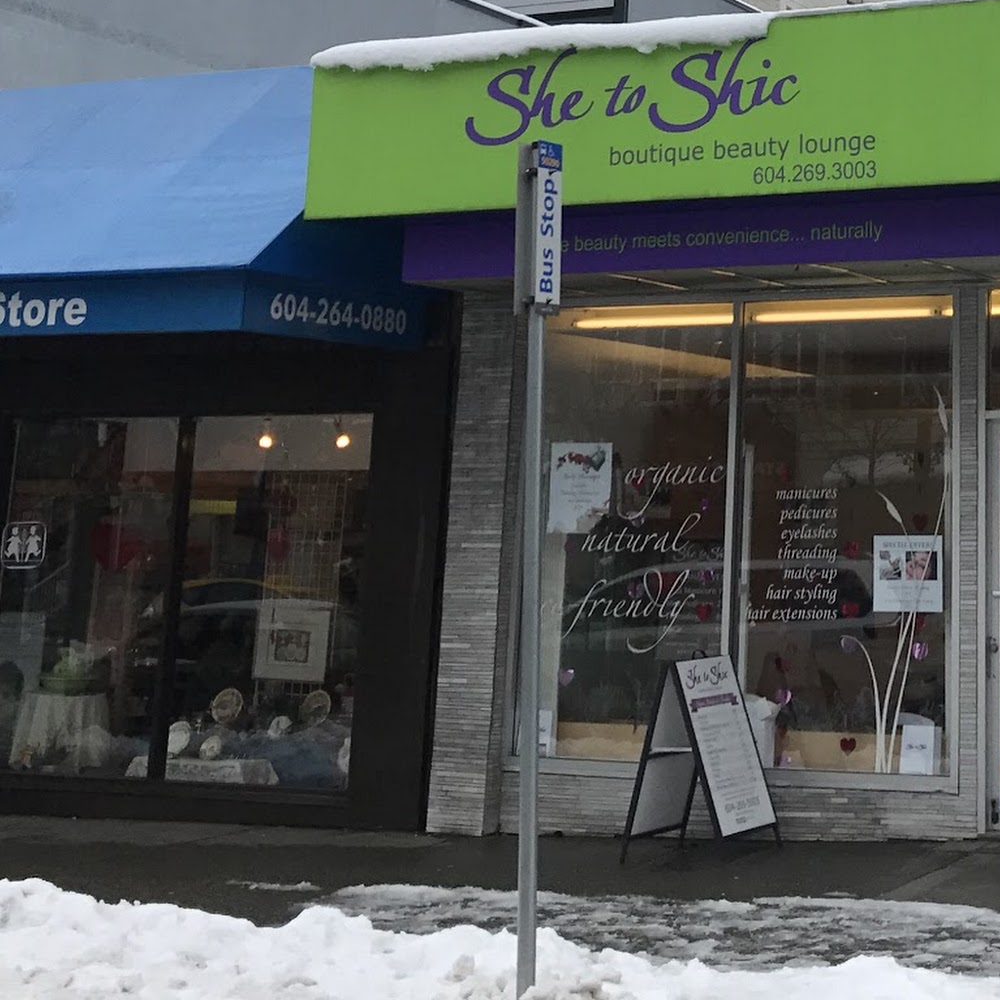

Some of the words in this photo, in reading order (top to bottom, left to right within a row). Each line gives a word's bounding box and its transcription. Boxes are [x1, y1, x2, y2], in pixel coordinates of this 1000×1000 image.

[465, 45, 594, 146] She
[605, 75, 646, 117] to
[648, 36, 800, 133] Shic
[609, 143, 704, 166] boutique
[714, 137, 789, 161] beauty
[800, 133, 876, 156] lounge
[753, 160, 877, 184] 604.269.3003
[540, 178, 558, 238] Stop
[575, 235, 626, 253] beauty
[632, 232, 681, 249] meets
[811, 220, 883, 242] naturally
[539, 247, 554, 294] Bus
[270, 292, 407, 335] 604-264-0880
[617, 456, 724, 520] organic
[776, 486, 838, 500] manicures
[779, 504, 838, 524] pedicures
[581, 513, 701, 553] natural
[781, 523, 838, 544] eyelashes
[778, 544, 838, 563] threading
[783, 564, 838, 583] make-up
[561, 568, 695, 654] friendly
[765, 584, 792, 600] hair
[794, 584, 838, 605] styling
[771, 605, 838, 623] extensions
